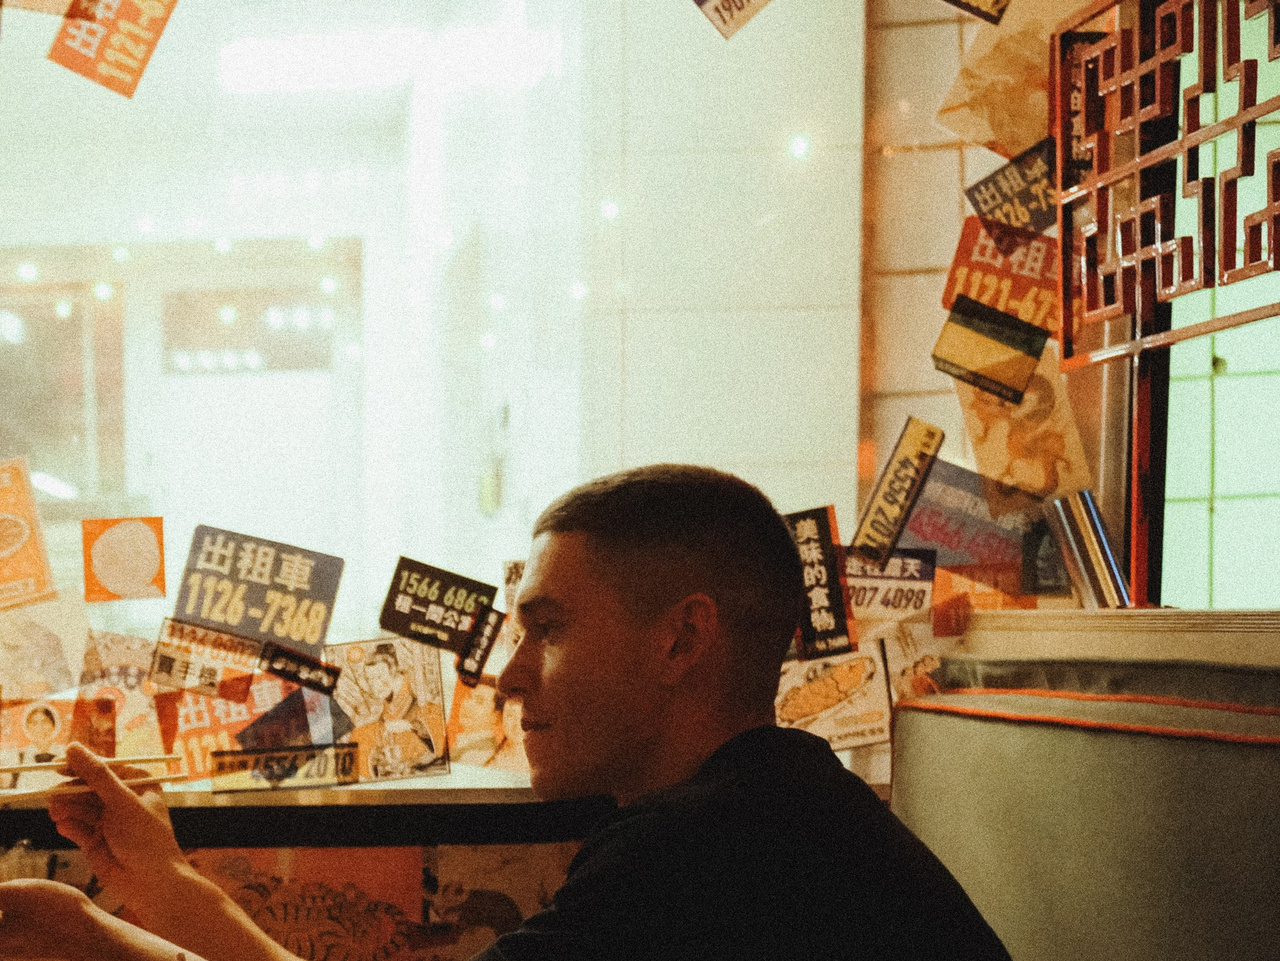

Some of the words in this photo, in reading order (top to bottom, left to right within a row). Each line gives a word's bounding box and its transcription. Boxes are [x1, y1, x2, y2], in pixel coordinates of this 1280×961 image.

[194, 533, 315, 593] 出租車
[396, 569, 441, 602] 1566
[185, 572, 328, 646] 1126-7368
